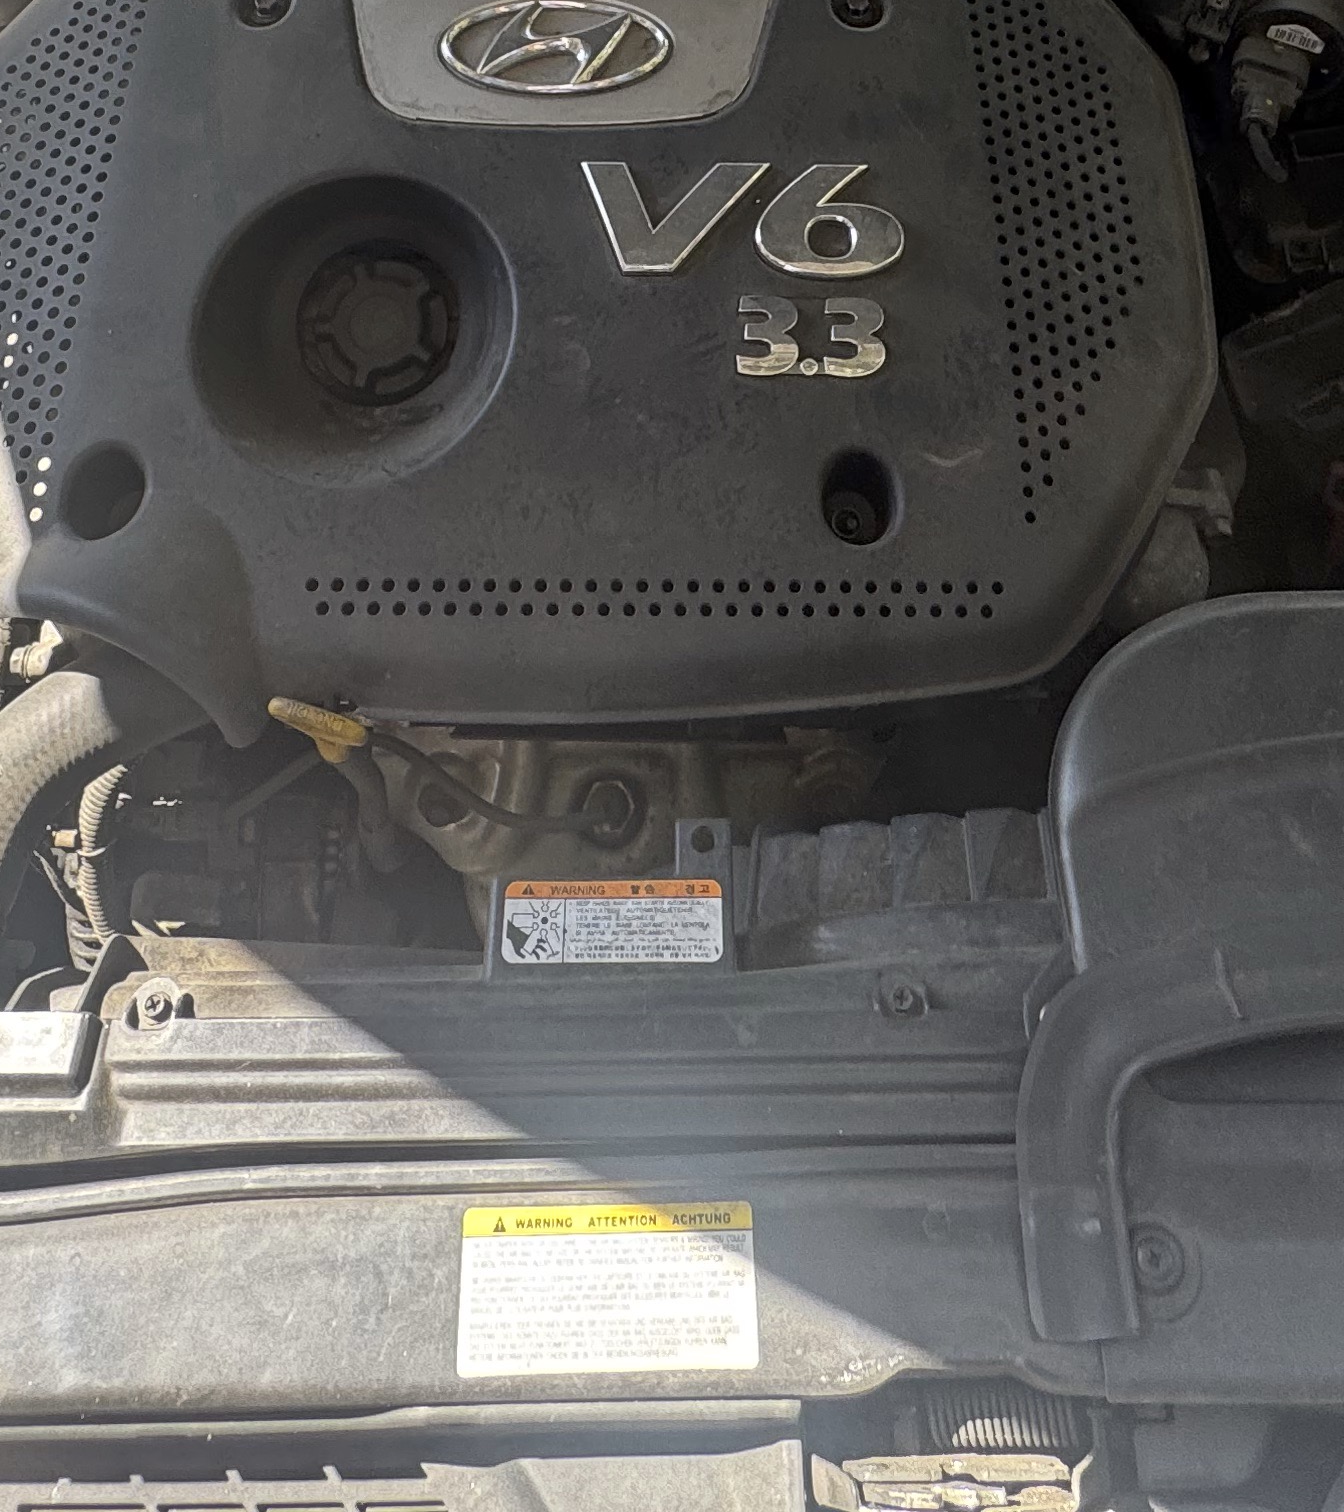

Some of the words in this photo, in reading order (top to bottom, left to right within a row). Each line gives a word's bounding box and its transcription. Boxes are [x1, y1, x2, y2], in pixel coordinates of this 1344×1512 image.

[581, 161, 904, 279] V6
[735, 294, 886, 377] 3.3
[550, 885, 606, 896] WARNING
[515, 1217, 573, 1229] WARNING
[588, 1214, 658, 1228] ATTENTION
[672, 1212, 732, 1226] ACHTUNG
